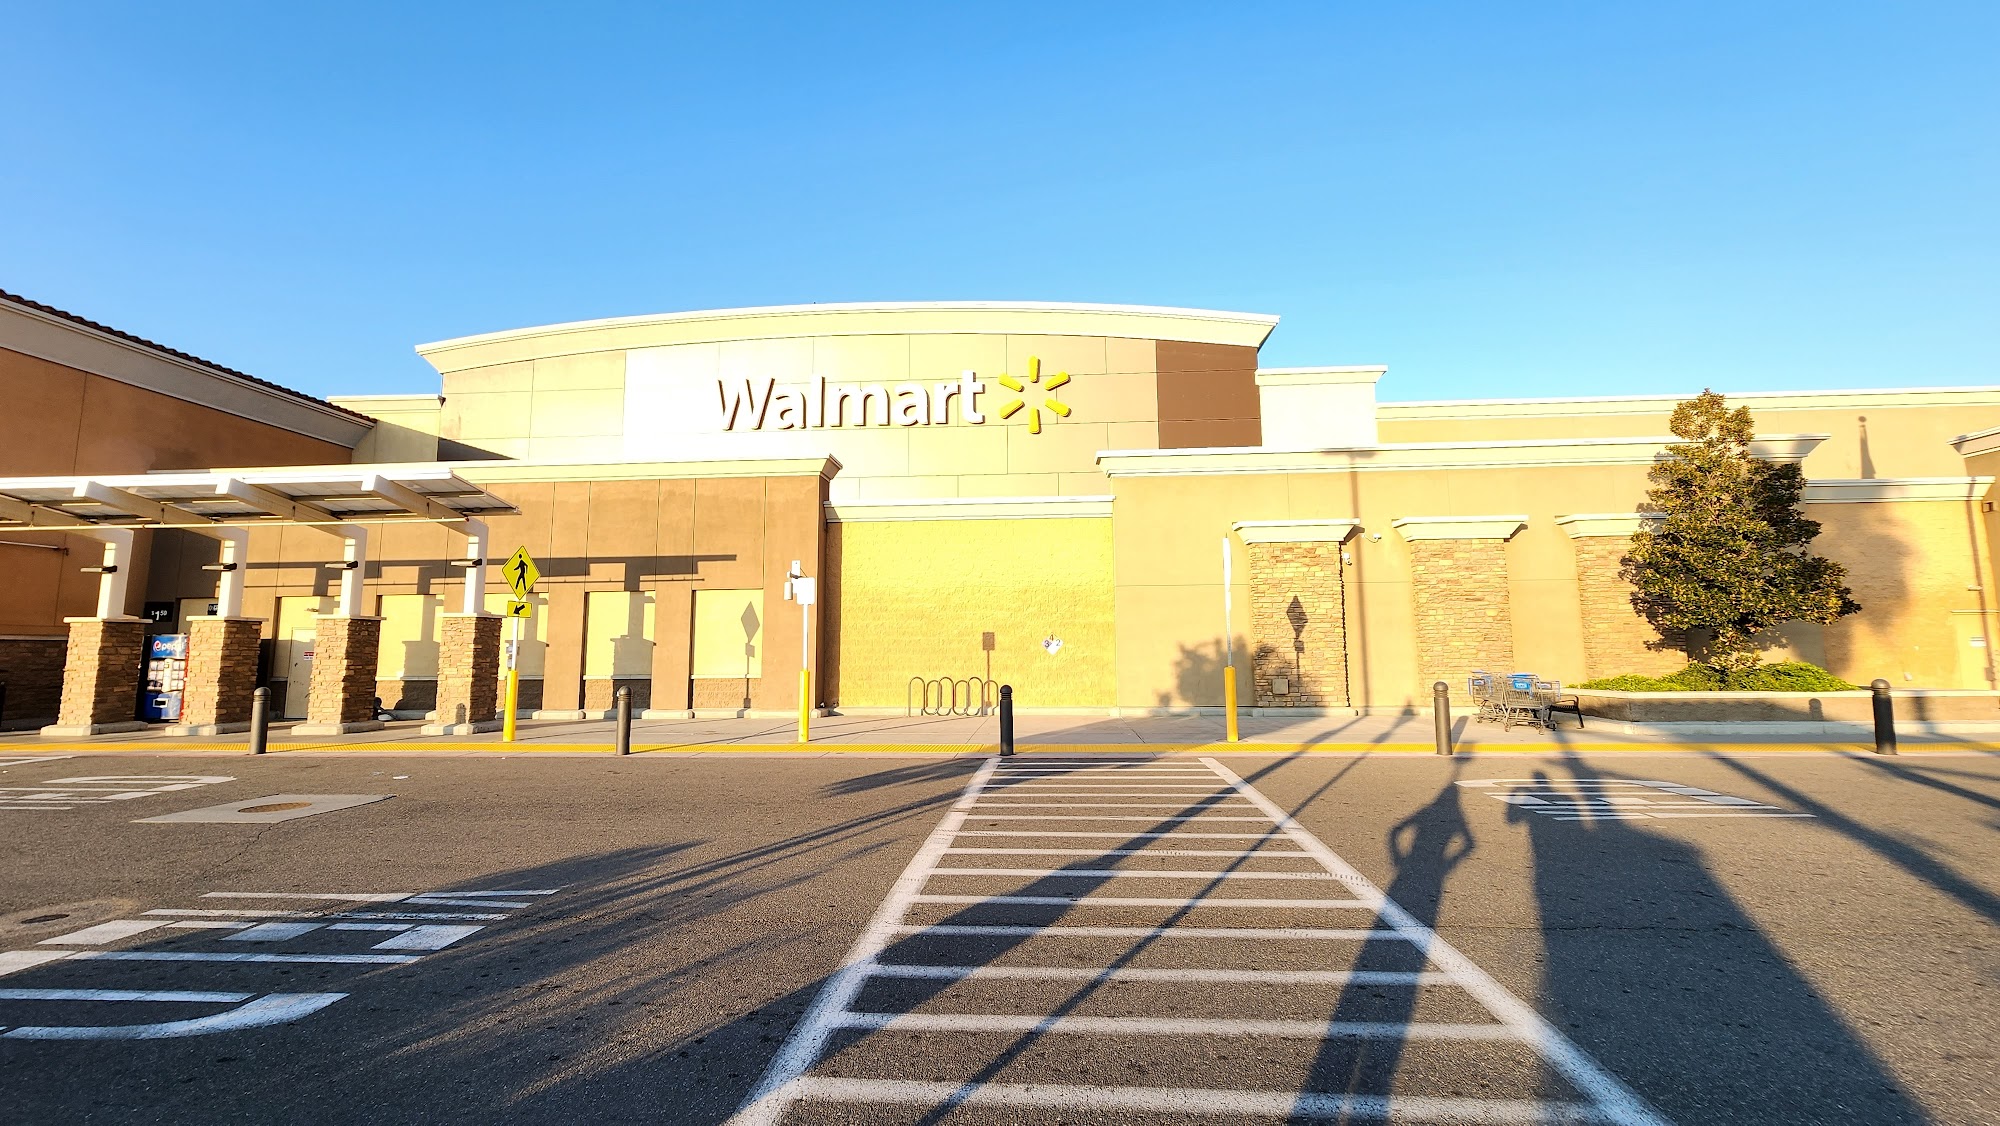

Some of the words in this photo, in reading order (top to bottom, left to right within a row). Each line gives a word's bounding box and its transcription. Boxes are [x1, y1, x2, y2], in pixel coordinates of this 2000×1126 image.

[715, 371, 986, 431] Walmart
[1044, 639, 1050, 648] 3
[1055, 638, 1061, 647] 2
[1453, 778, 1819, 821] YIELD
